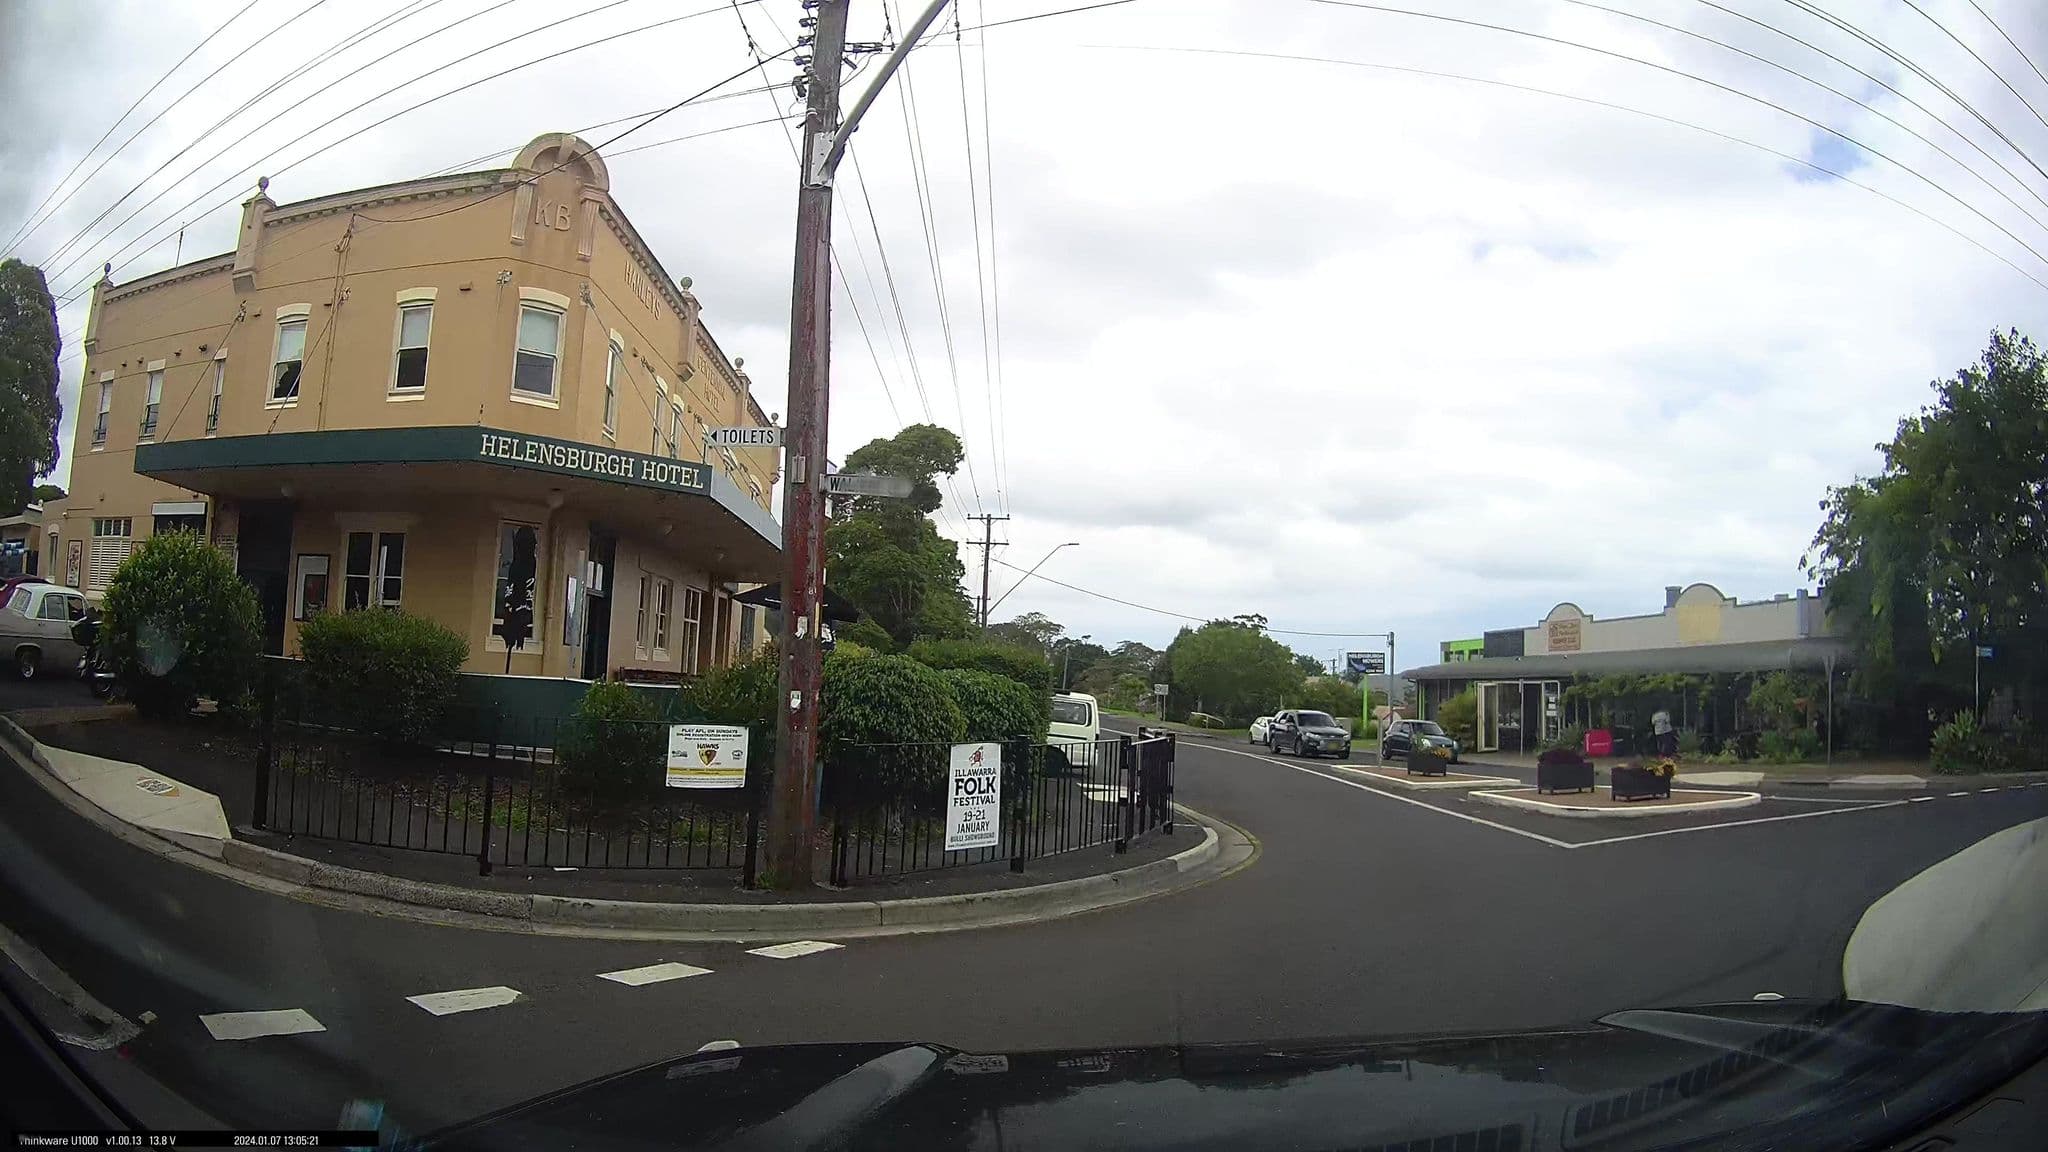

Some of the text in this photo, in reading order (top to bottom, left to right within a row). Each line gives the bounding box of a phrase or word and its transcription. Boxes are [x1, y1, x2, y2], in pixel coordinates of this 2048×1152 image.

[535, 198, 571, 232] KB
[722, 429, 774, 444] TOILETS
[480, 433, 703, 489] HELENSBURGH HOTEL
[955, 768, 996, 777] ILLAWARRA
[954, 776, 996, 796] FOLK
[953, 795, 995, 807] FESTIVAL
[963, 809, 986, 822] 19-21
[957, 821, 990, 834] JANUARY
